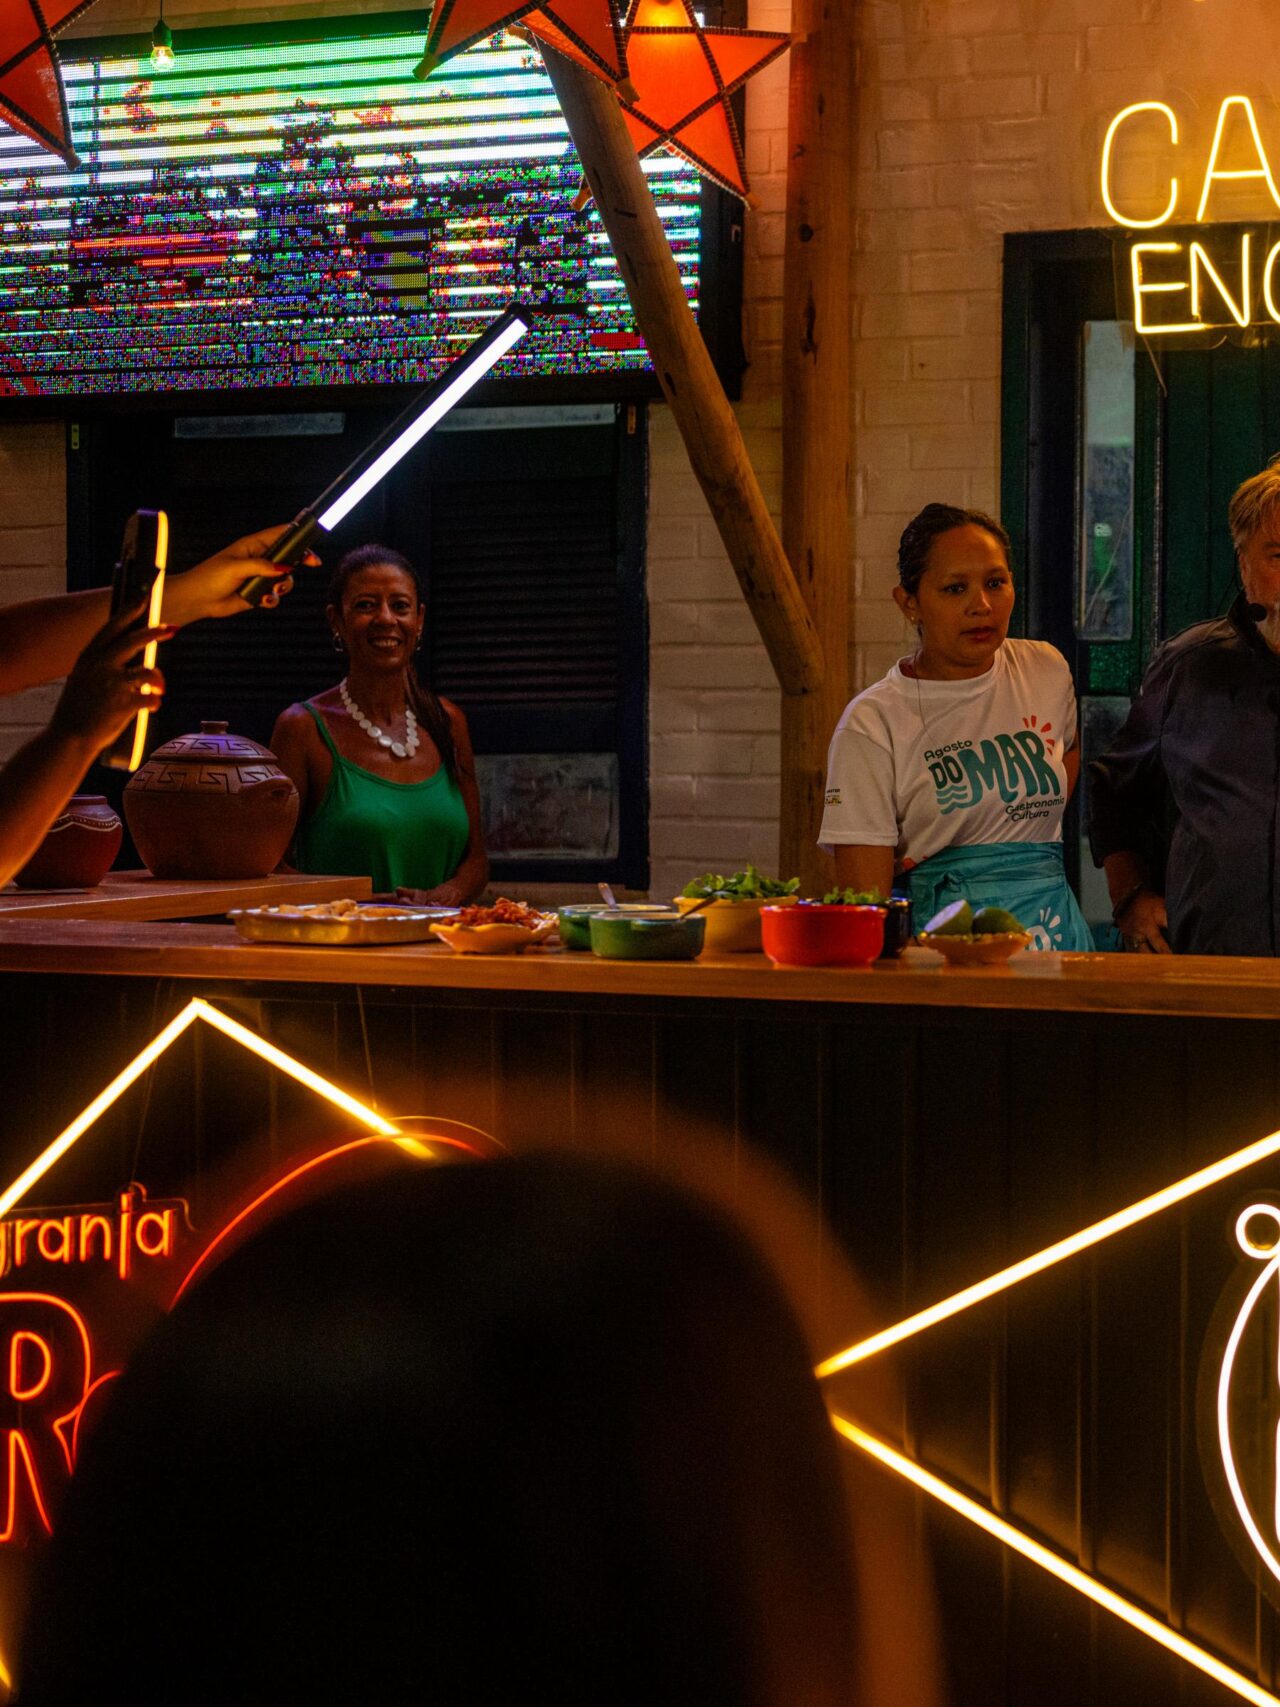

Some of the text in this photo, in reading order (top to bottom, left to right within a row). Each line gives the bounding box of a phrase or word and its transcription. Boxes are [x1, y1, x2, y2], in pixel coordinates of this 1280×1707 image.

[923, 739, 973, 762] Agosto
[928, 730, 1061, 805] DO MAR
[1011, 810, 1050, 822] Cultura
[0, 1192, 176, 1280] ranja
